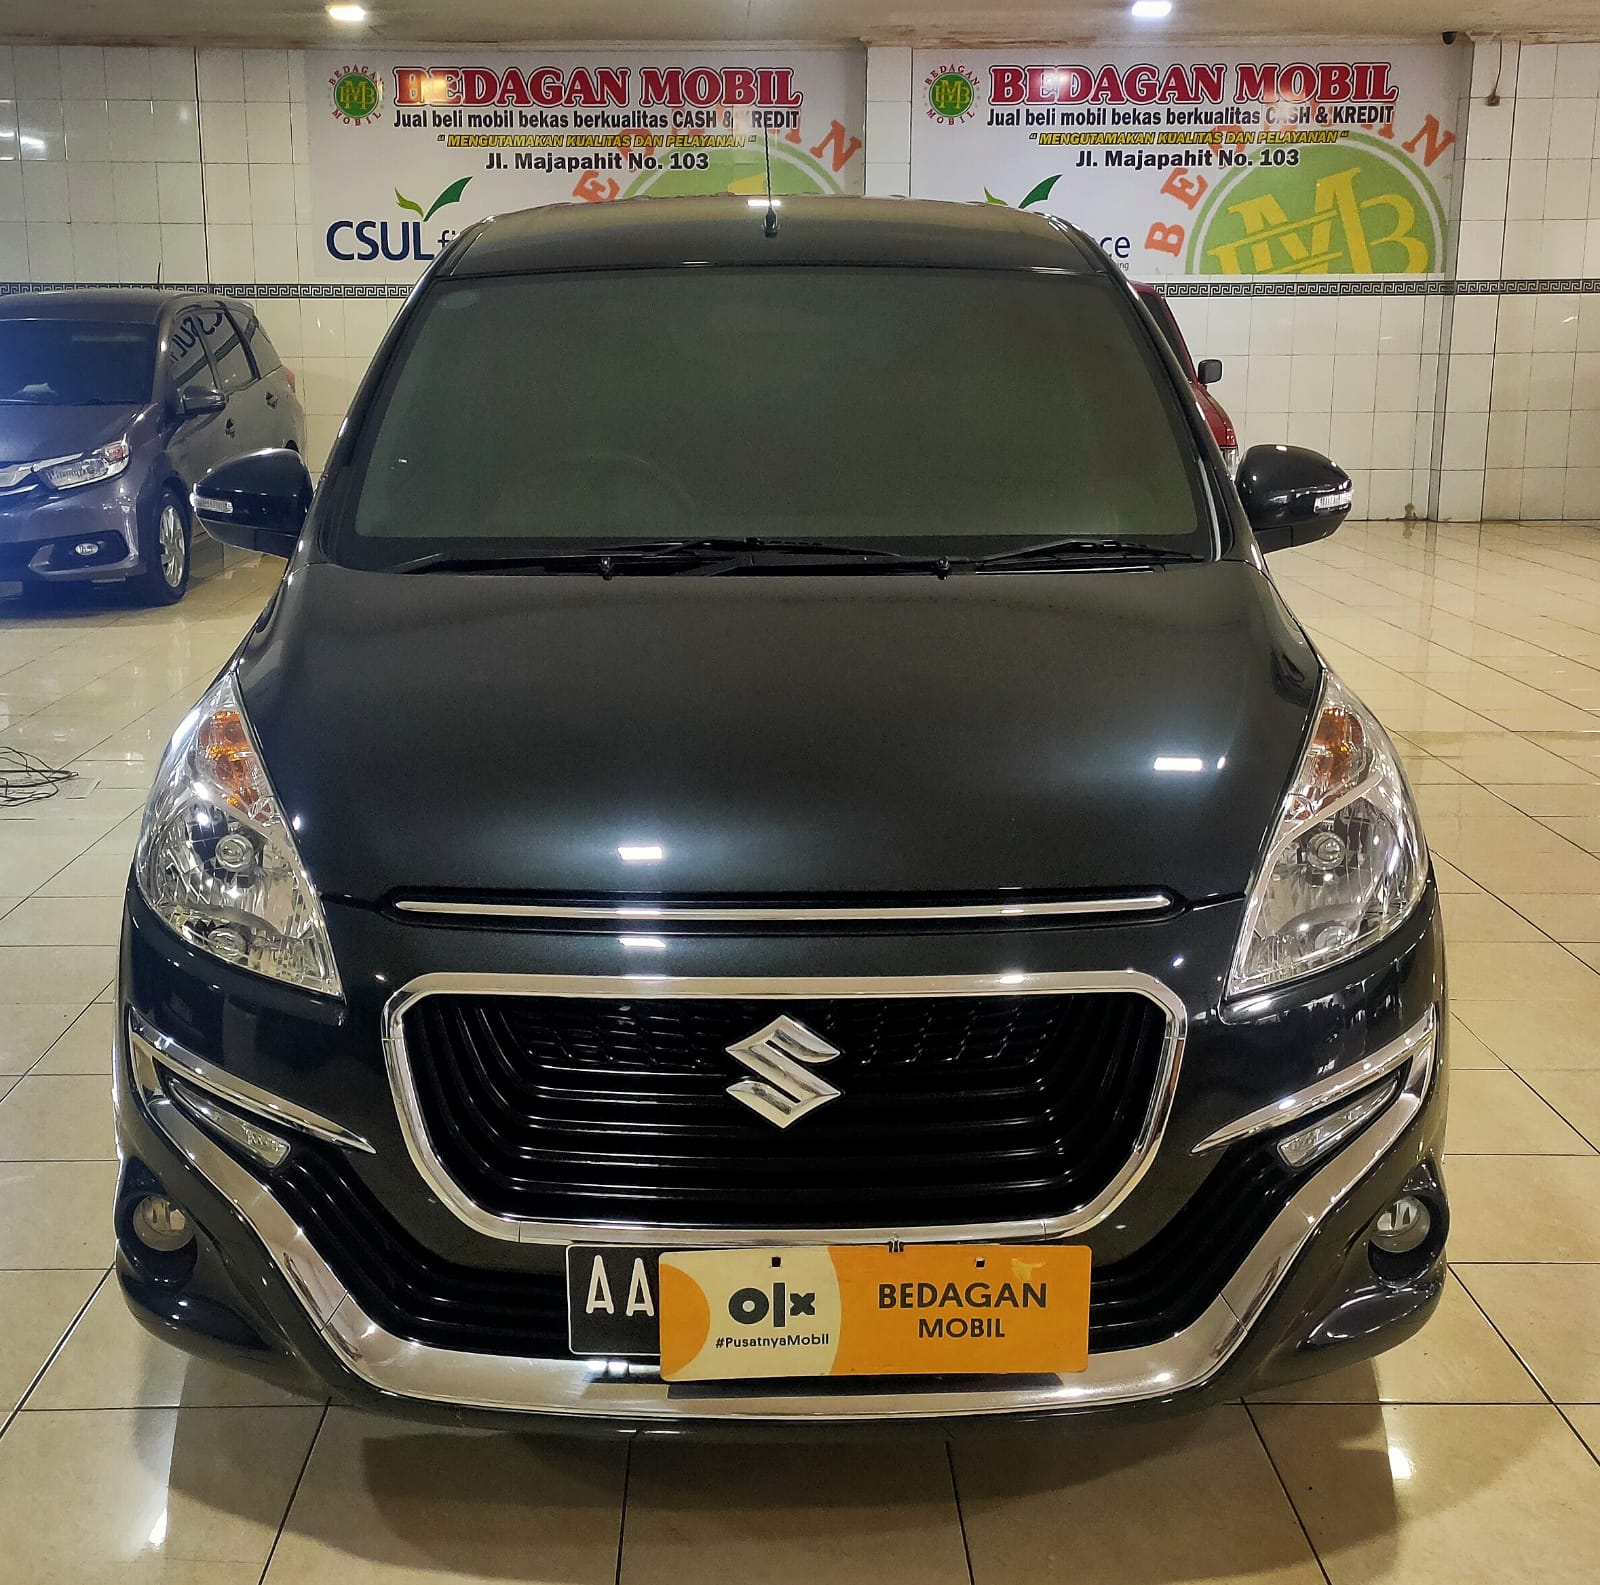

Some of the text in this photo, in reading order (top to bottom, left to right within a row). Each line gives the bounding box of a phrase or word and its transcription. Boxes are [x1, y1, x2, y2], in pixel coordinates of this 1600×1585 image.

[393, 67, 803, 107] BEDAGAN MOBIL
[989, 62, 1398, 105] BEDAGAN MOBIL
[394, 110, 427, 128] Jual
[432, 110, 462, 128] beli
[468, 110, 513, 128] mobil
[519, 110, 568, 128] bekas
[574, 110, 668, 128] berkualitas
[673, 111, 716, 128] CASH
[738, 111, 799, 128] REDIT
[987, 109, 1021, 126] Jual
[1026, 109, 1056, 126] beli
[1061, 108, 1106, 126] mobil
[1112, 108, 1161, 125] bekas
[1167, 106, 1260, 125] berkualitas
[1315, 106, 1329, 124] &
[1333, 106, 1394, 124] KREDIT
[447, 134, 563, 147] MENGUTAMAKAN
[566, 134, 631, 147] KUALITAS
[634, 134, 663, 147] DAN
[666, 134, 745, 147] PELAYANAN
[1039, 132, 1155, 145] MENGUTAMAKAN
[1157, 132, 1222, 145] KUALITAS
[1225, 131, 1254, 144] DAN
[1257, 131, 1338, 144] PELAYANAN
[486, 153, 709, 172] Jl. Majapahit No. 103
[1076, 149, 1299, 170] Jl. Majapahit No. 103
[326, 221, 434, 261] CSUL
[586, 1255, 655, 1317] AA
[878, 1282, 1047, 1309] BEDAGAN
[728, 1282, 816, 1328] olx
[918, 1318, 1005, 1338] MOBIL
[715, 1333, 830, 1349] #PusatnyaMobil
